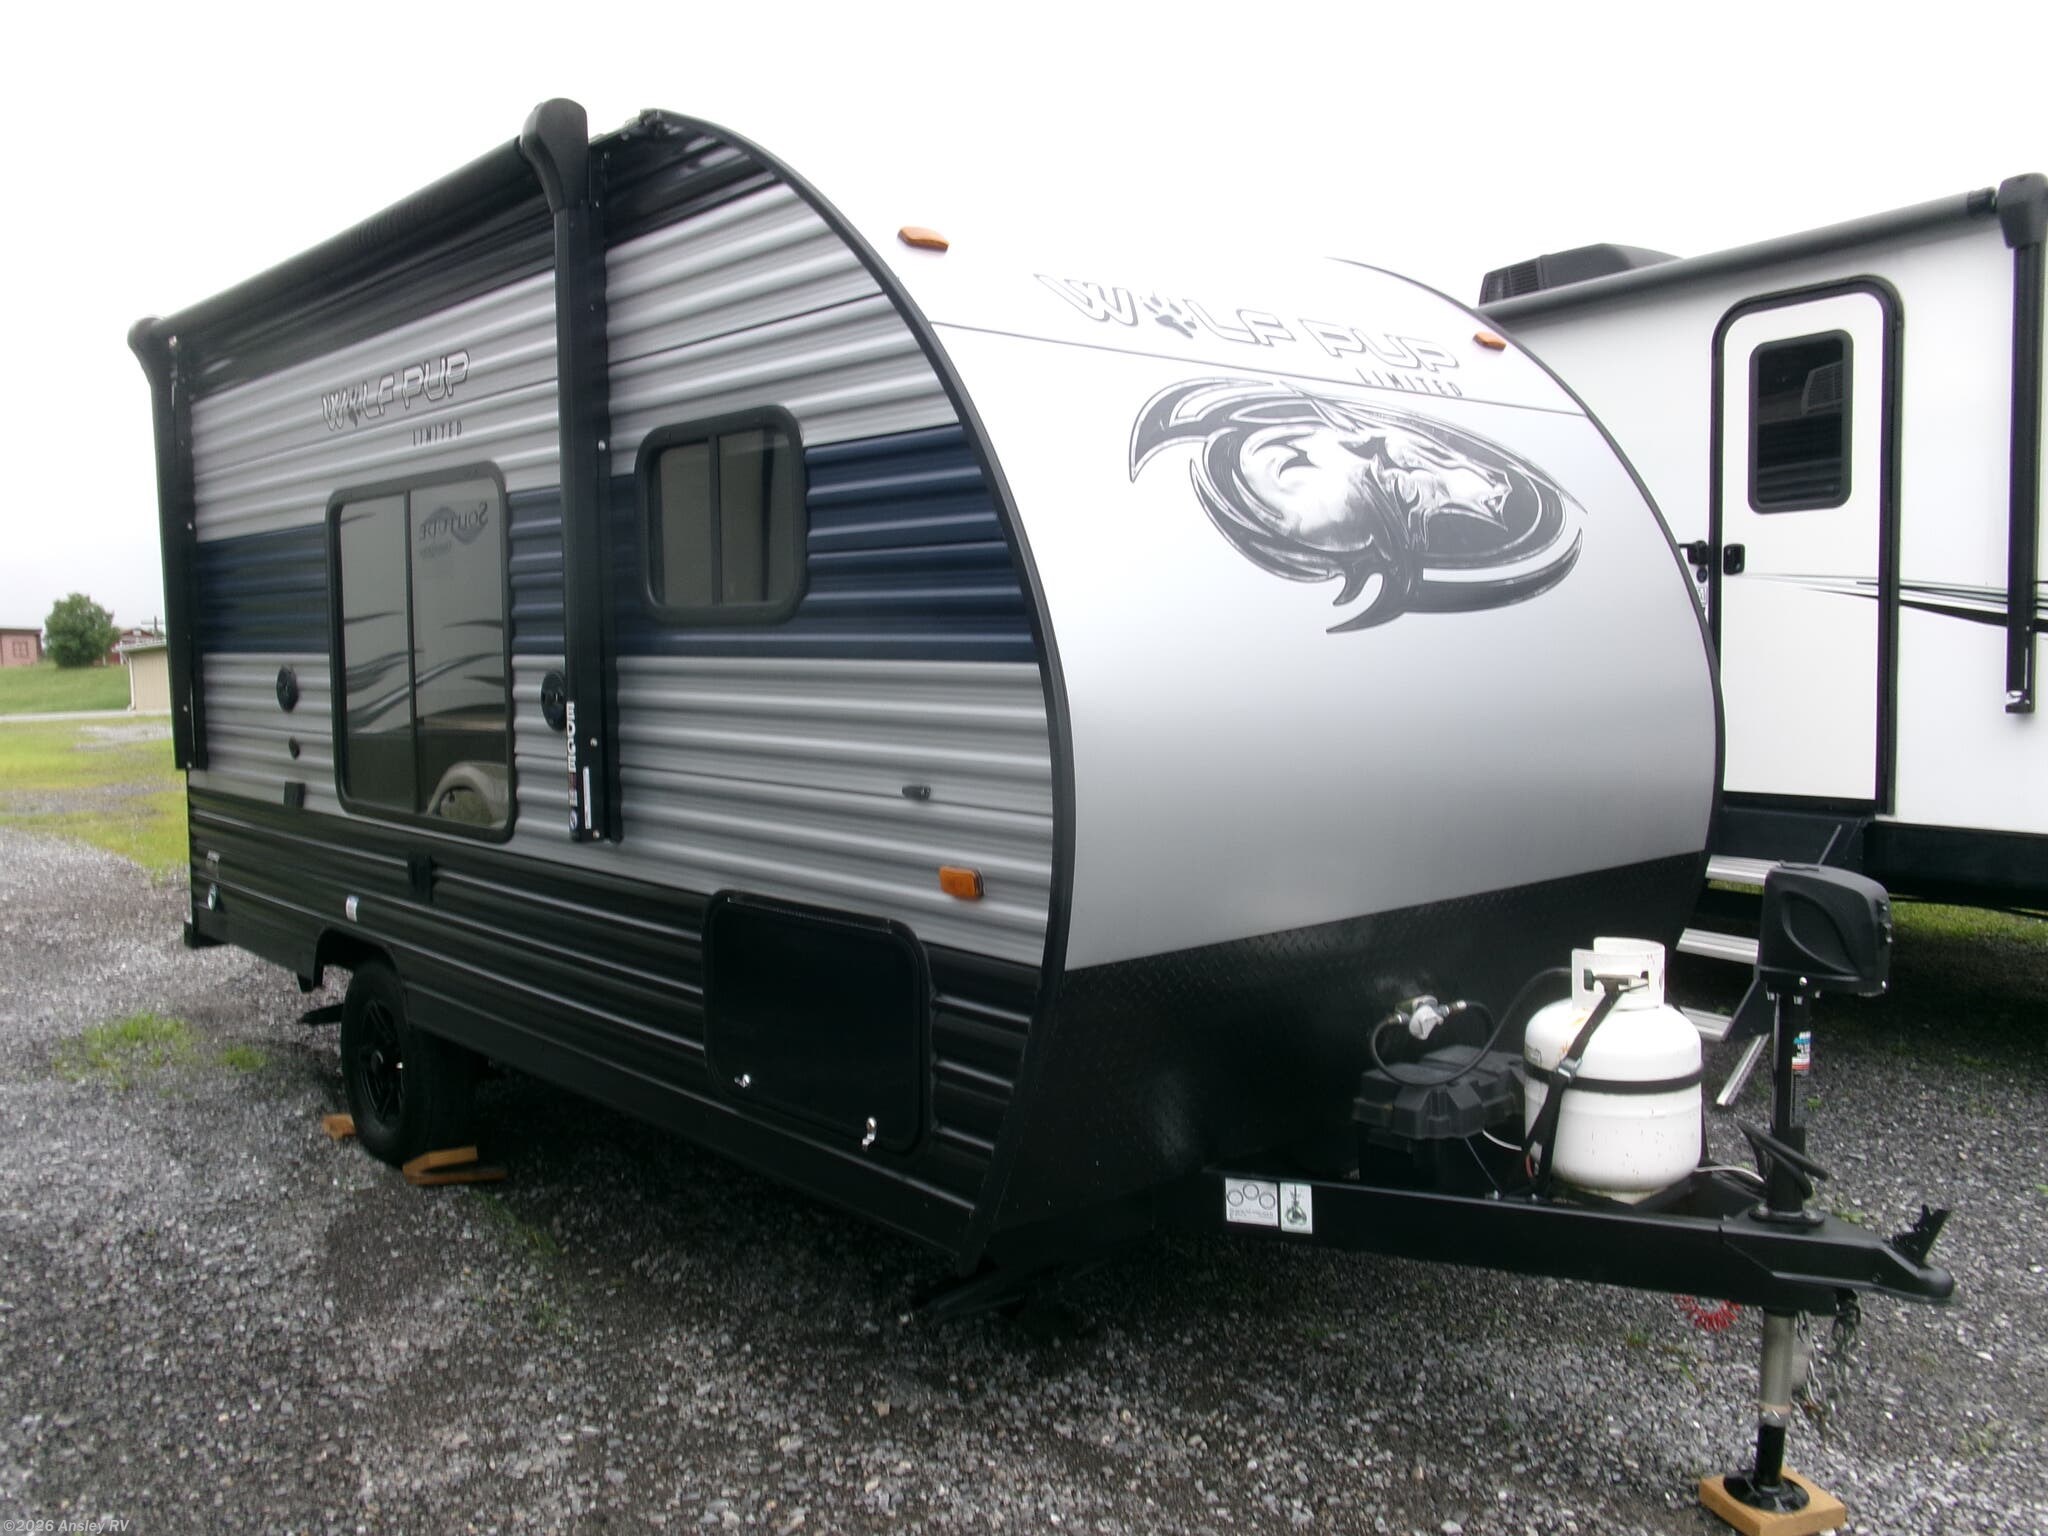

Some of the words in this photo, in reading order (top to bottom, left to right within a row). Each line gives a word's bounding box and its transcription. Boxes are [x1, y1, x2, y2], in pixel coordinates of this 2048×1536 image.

[1298, 317, 1460, 372] PUP
[402, 350, 470, 410] PUP
[1354, 367, 1462, 397] LIMITED
[412, 418, 463, 446] LIMITED
